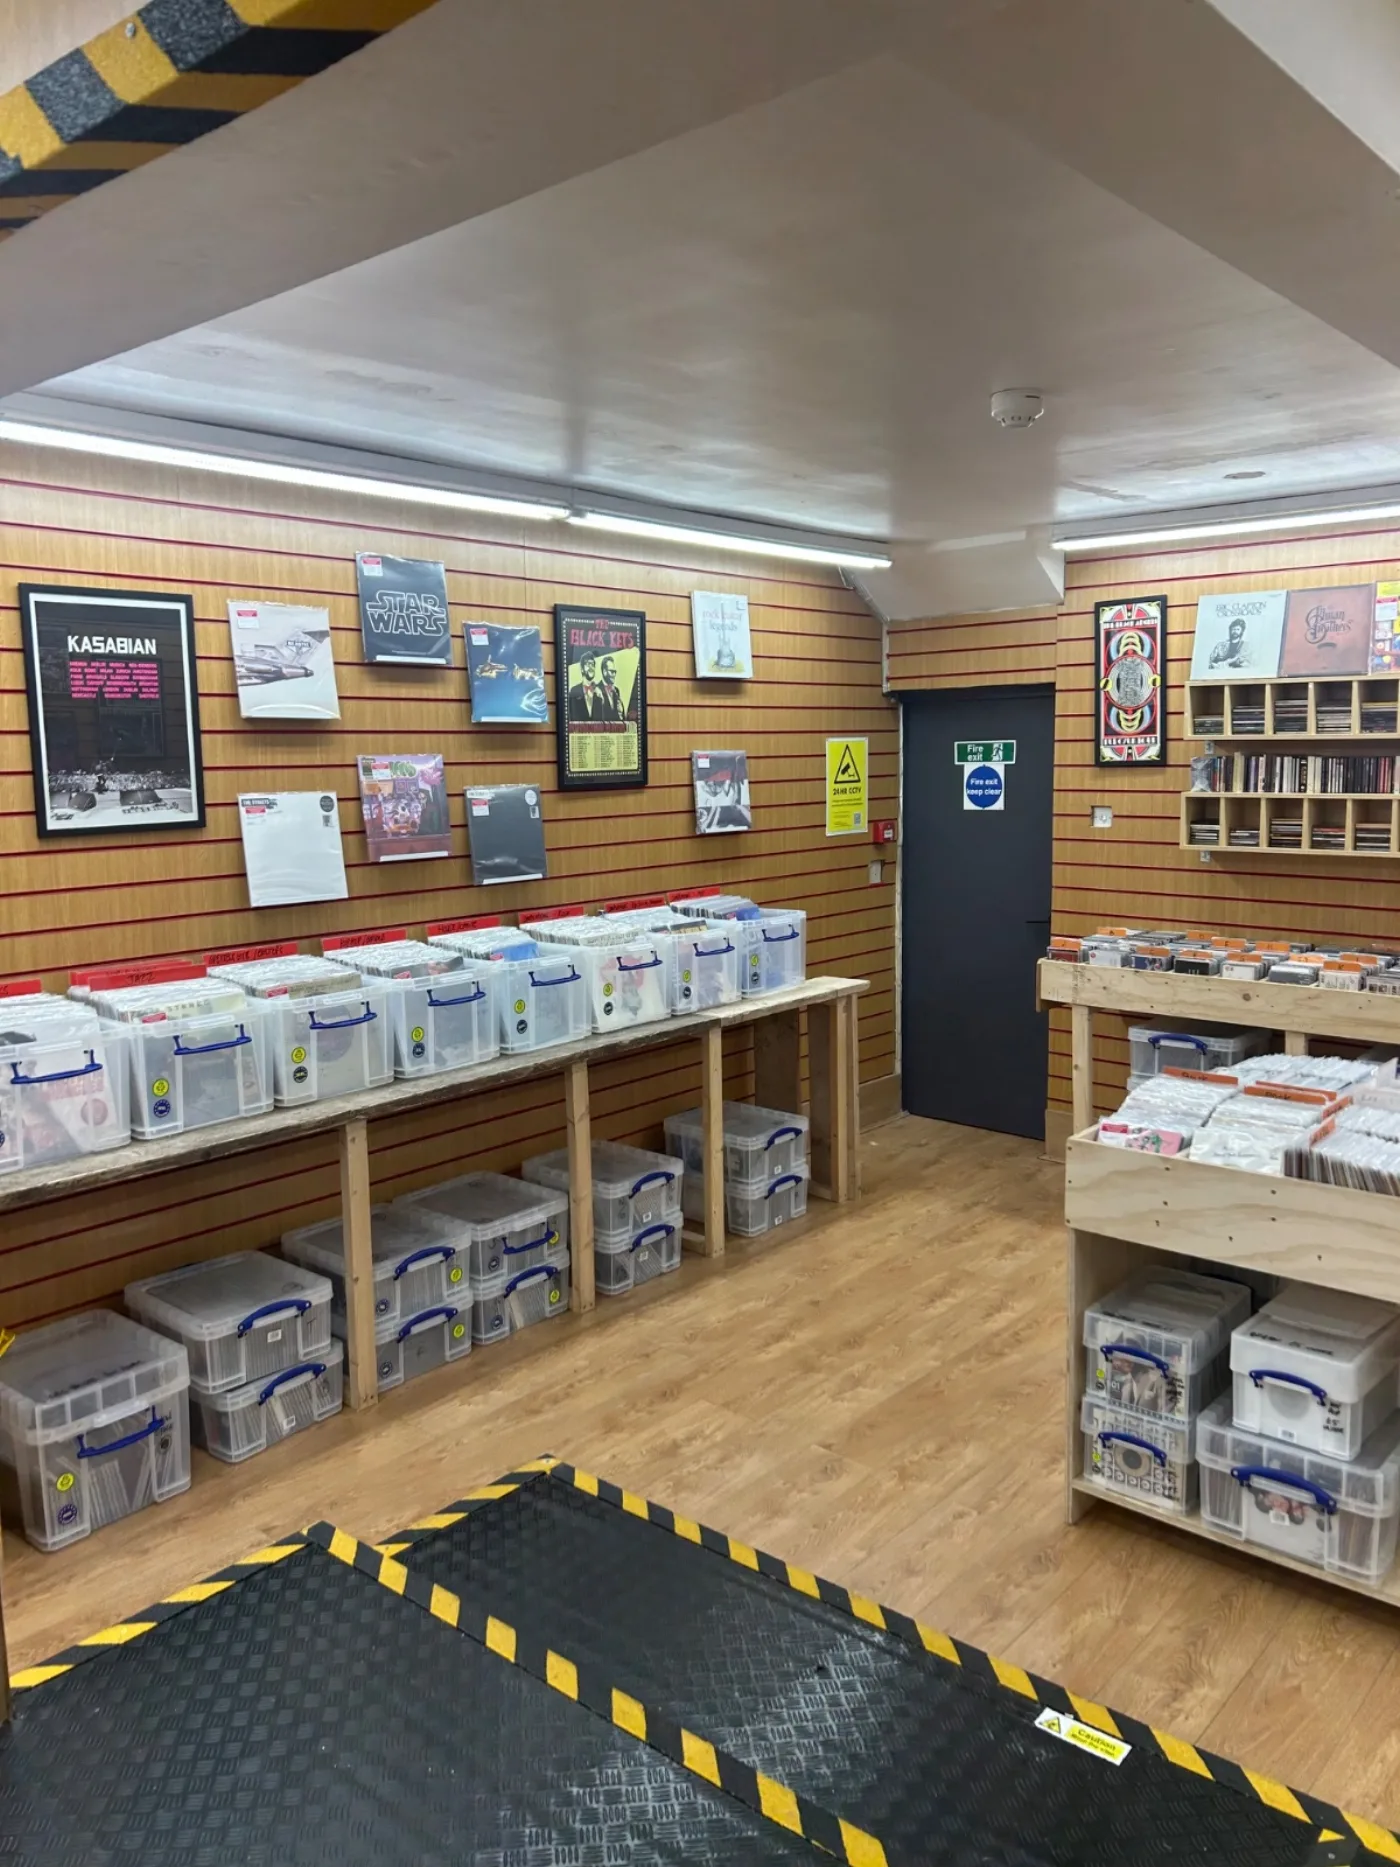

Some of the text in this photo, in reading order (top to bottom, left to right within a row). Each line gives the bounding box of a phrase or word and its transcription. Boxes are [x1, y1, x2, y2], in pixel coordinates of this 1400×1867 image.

[366, 590, 446, 616] STAR
[368, 611, 447, 636] WARS
[594, 619, 609, 630] THE
[67, 635, 157, 655] KASABIAN
[570, 629, 634, 650] BLACK KEYS
[967, 744, 983, 753] Fire
[967, 753, 983, 761] exit
[848, 786, 862, 794] CCTV
[967, 788, 983, 796] keep
[126, 972, 155, 985] JAZZ
[1078, 1728, 1117, 1751] Caution
